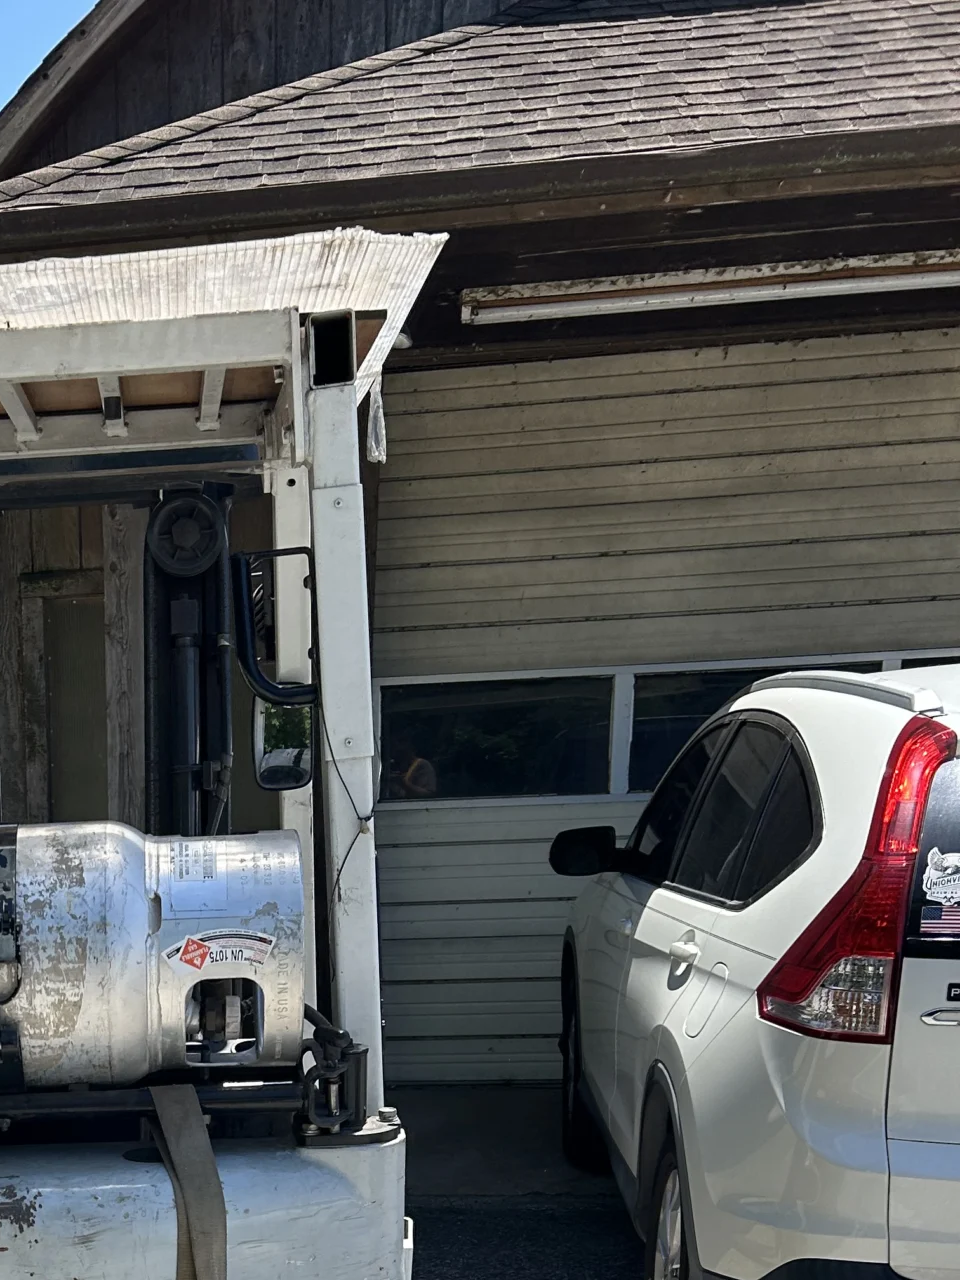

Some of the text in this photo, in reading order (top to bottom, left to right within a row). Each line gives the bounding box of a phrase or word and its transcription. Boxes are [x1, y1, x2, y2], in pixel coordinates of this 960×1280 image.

[209, 949, 244, 964] UN 1075
[277, 982, 289, 994] IN
[277, 999, 289, 1021] USA
